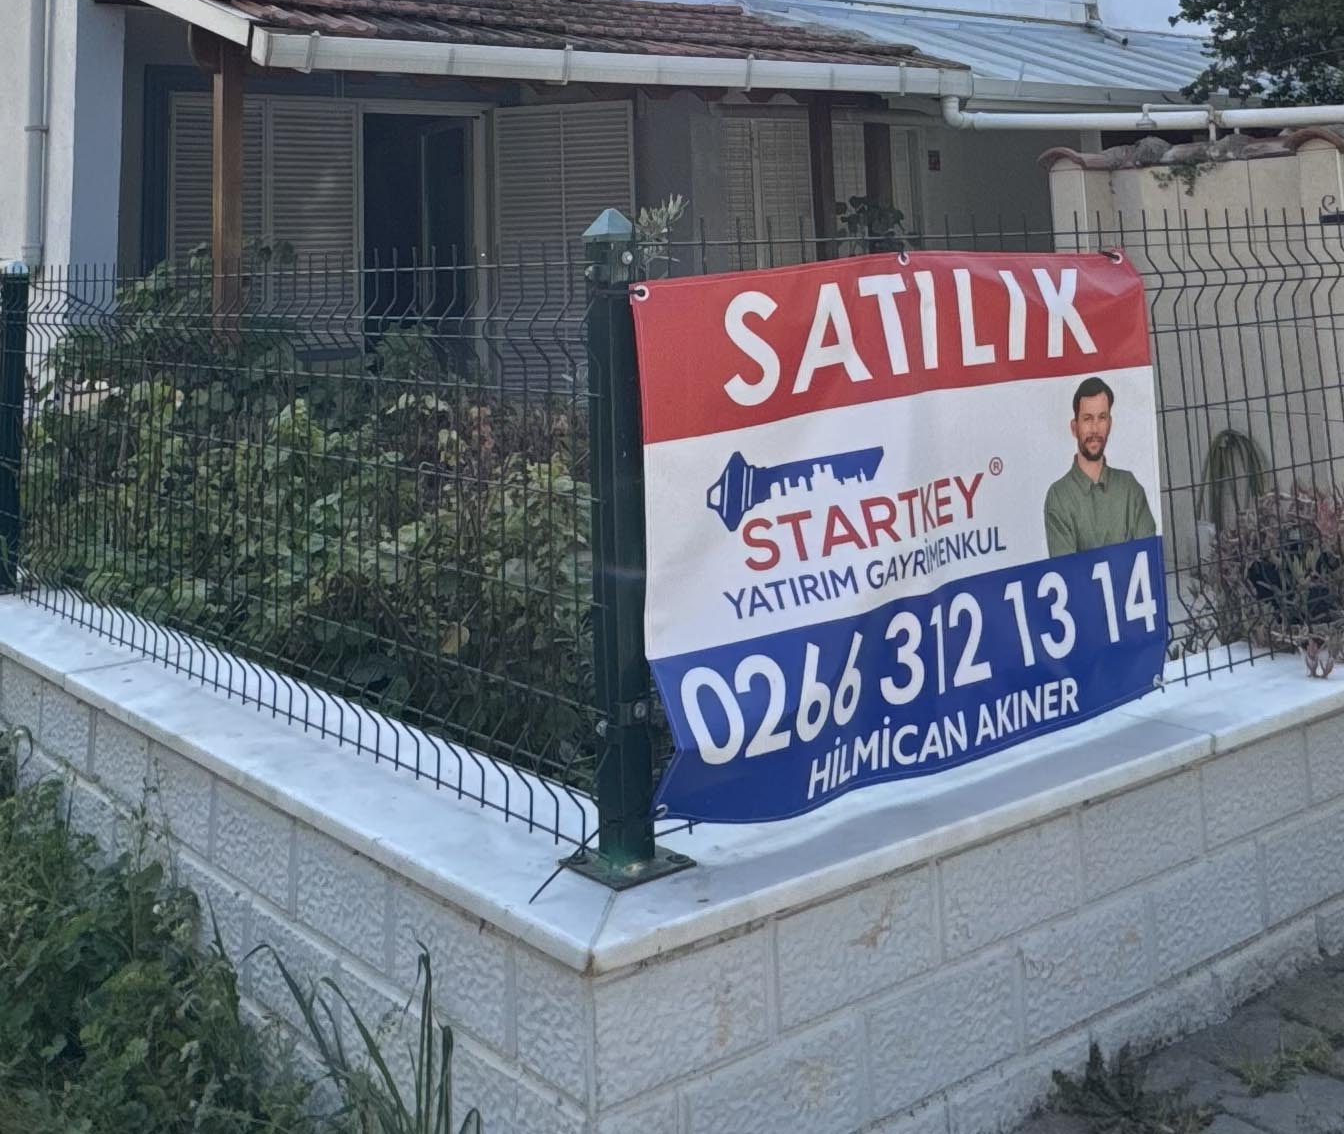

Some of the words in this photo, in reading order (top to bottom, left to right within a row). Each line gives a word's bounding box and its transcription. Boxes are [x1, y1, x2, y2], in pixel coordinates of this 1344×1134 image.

[723, 268, 1098, 407] SATILIK
[723, 565, 860, 620] YATIRIM
[865, 526, 1007, 590] GAYRİMENKUL
[742, 472, 985, 571] STARTKEY
[680, 630, 863, 765] 0266
[879, 591, 992, 706] 312
[1003, 571, 1077, 668] 13
[1091, 550, 1158, 644] 14
[807, 715, 969, 800] HİLMİCAN
[974, 676, 1081, 747] AKINER
